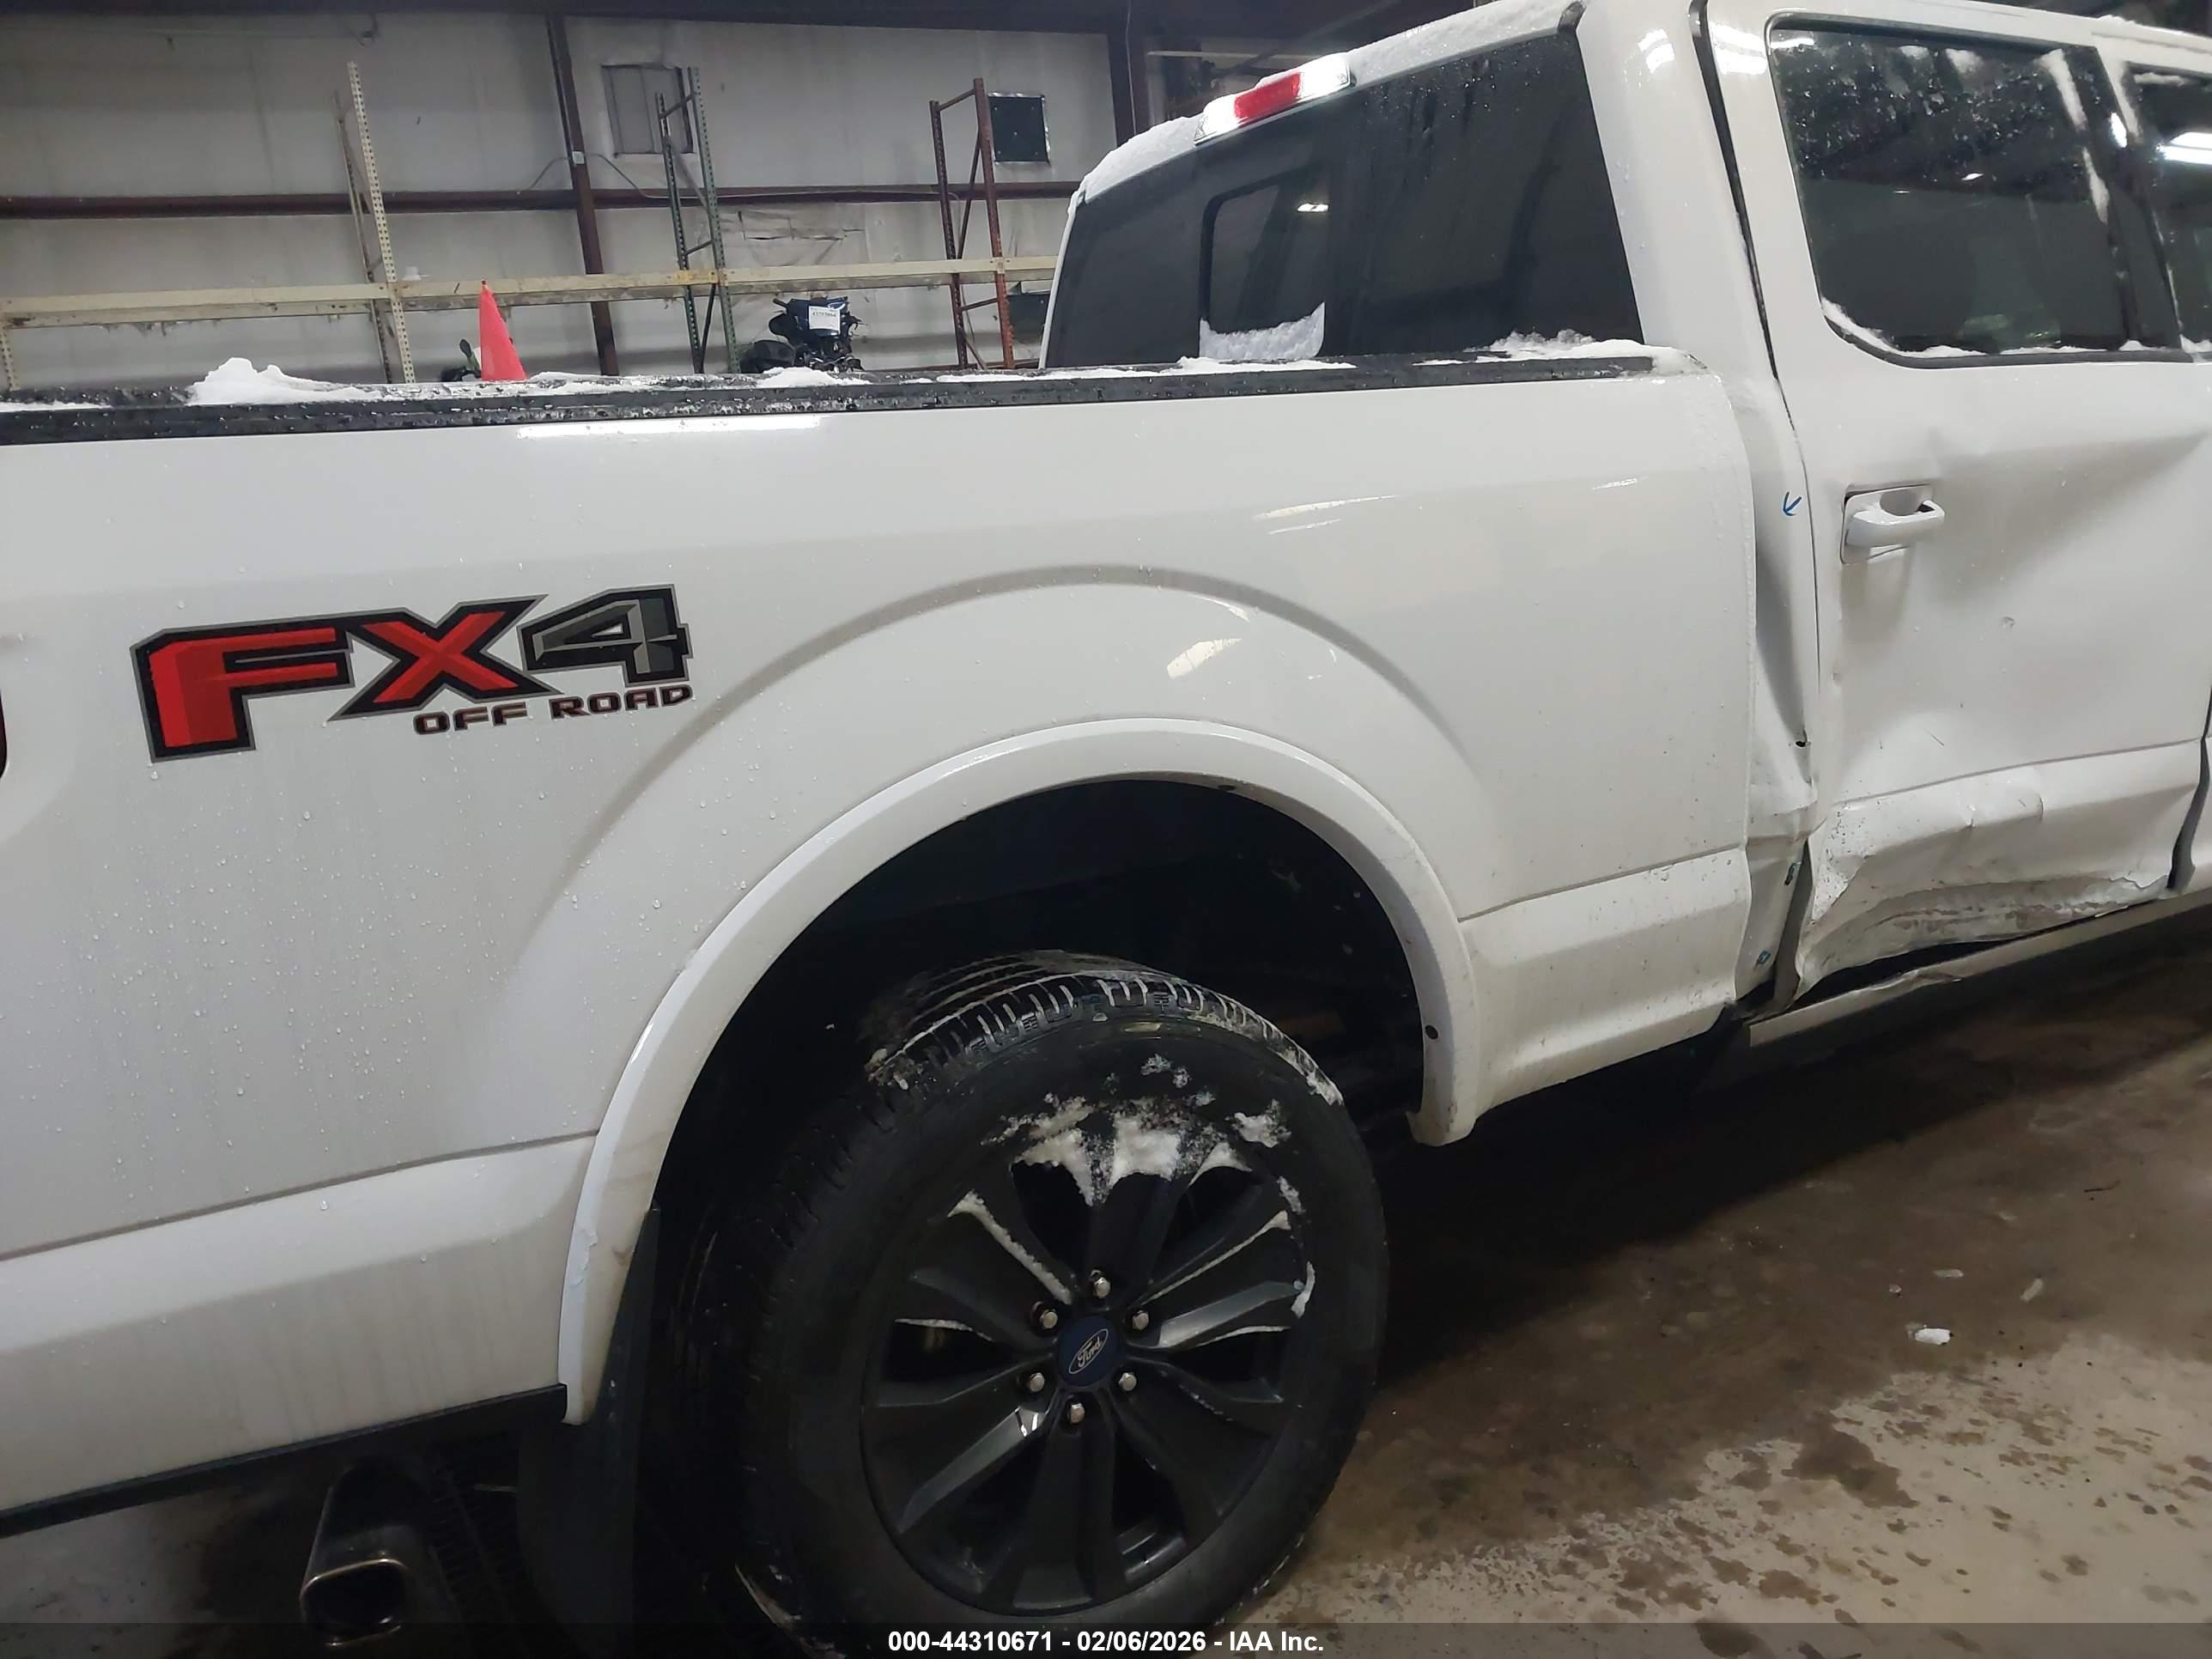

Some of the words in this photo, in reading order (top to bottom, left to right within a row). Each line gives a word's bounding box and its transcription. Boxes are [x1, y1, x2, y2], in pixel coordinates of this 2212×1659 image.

[130, 584, 693, 763] FX4
[412, 701, 529, 736] OFF
[548, 684, 694, 720] ROAD
[1076, 1335, 1103, 1368] Ford
